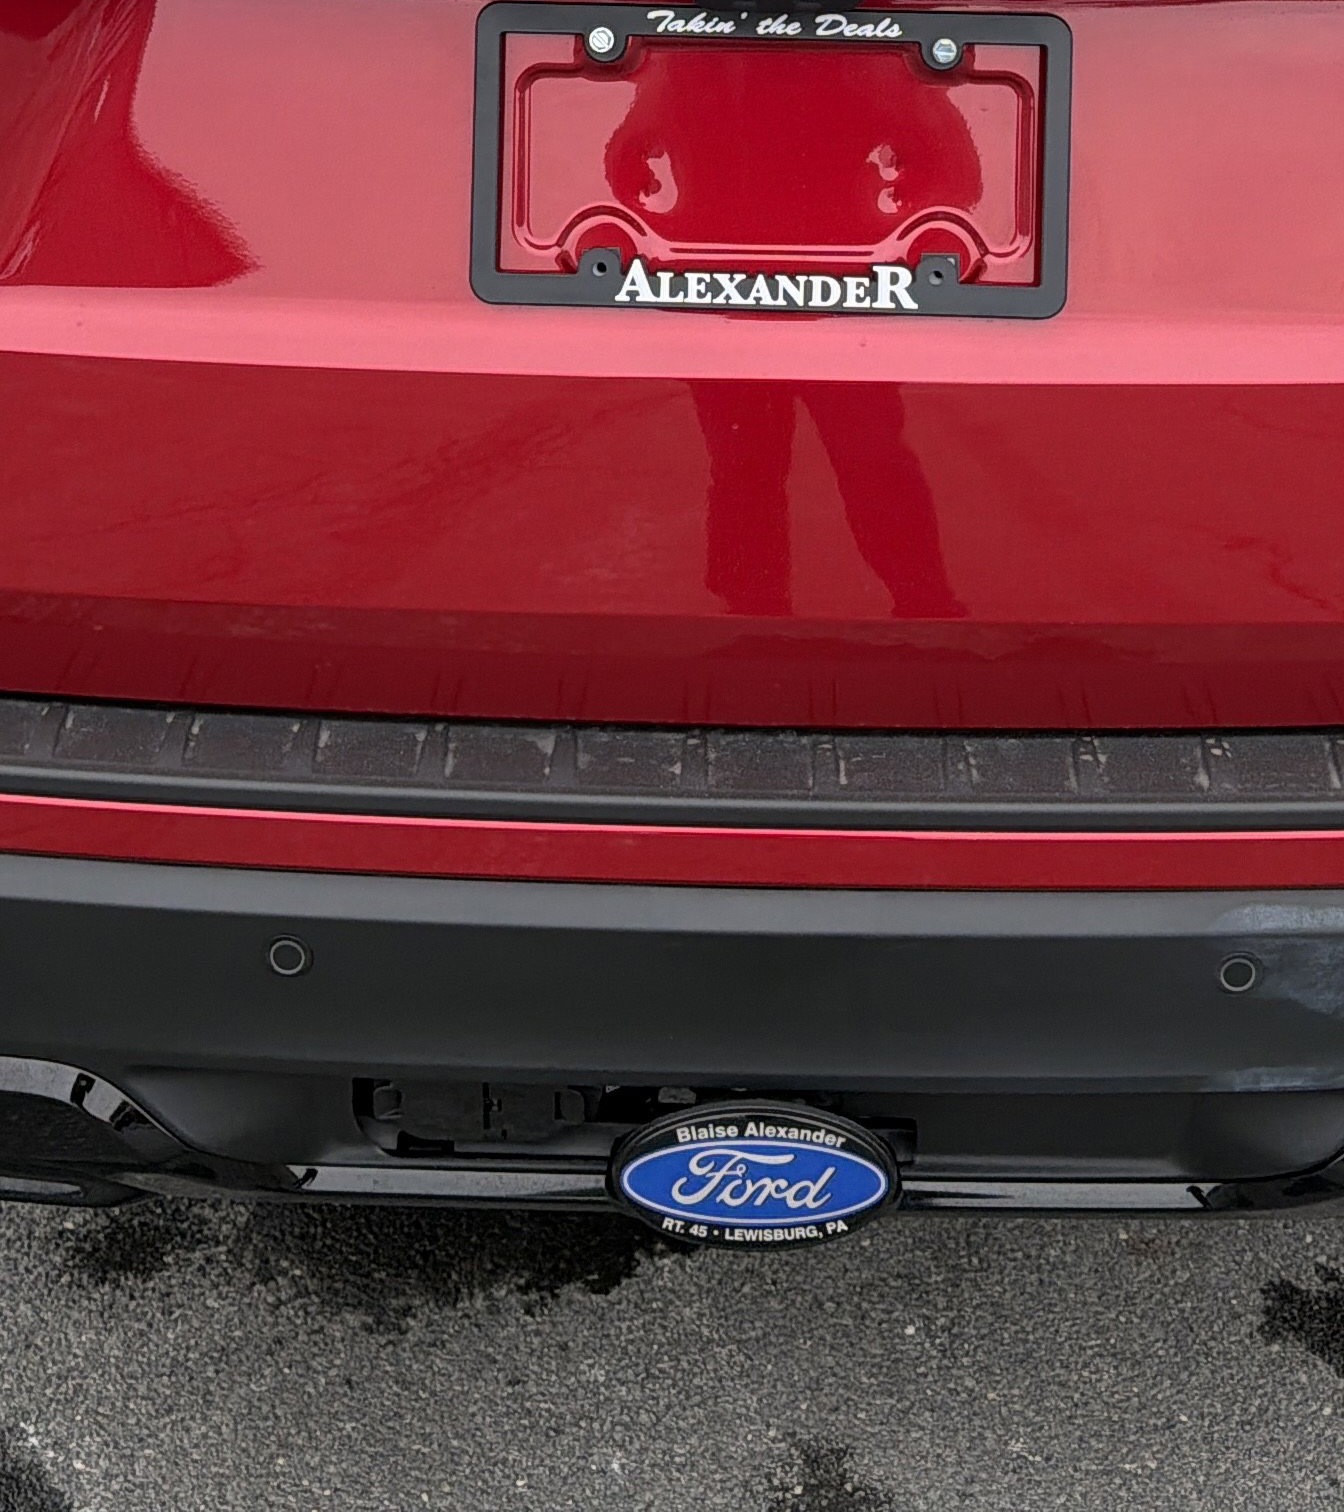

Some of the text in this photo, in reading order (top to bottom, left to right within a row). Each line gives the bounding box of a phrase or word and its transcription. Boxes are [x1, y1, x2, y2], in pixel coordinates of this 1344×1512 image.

[646, 10, 903, 39] Takin' the Deals
[615, 258, 919, 311] ALEXANDER
[676, 1121, 846, 1148] Blaise Alexander
[671, 1148, 837, 1209] Ford
[662, 1217, 849, 1242] RT. 45 LEWISBURG, PA
